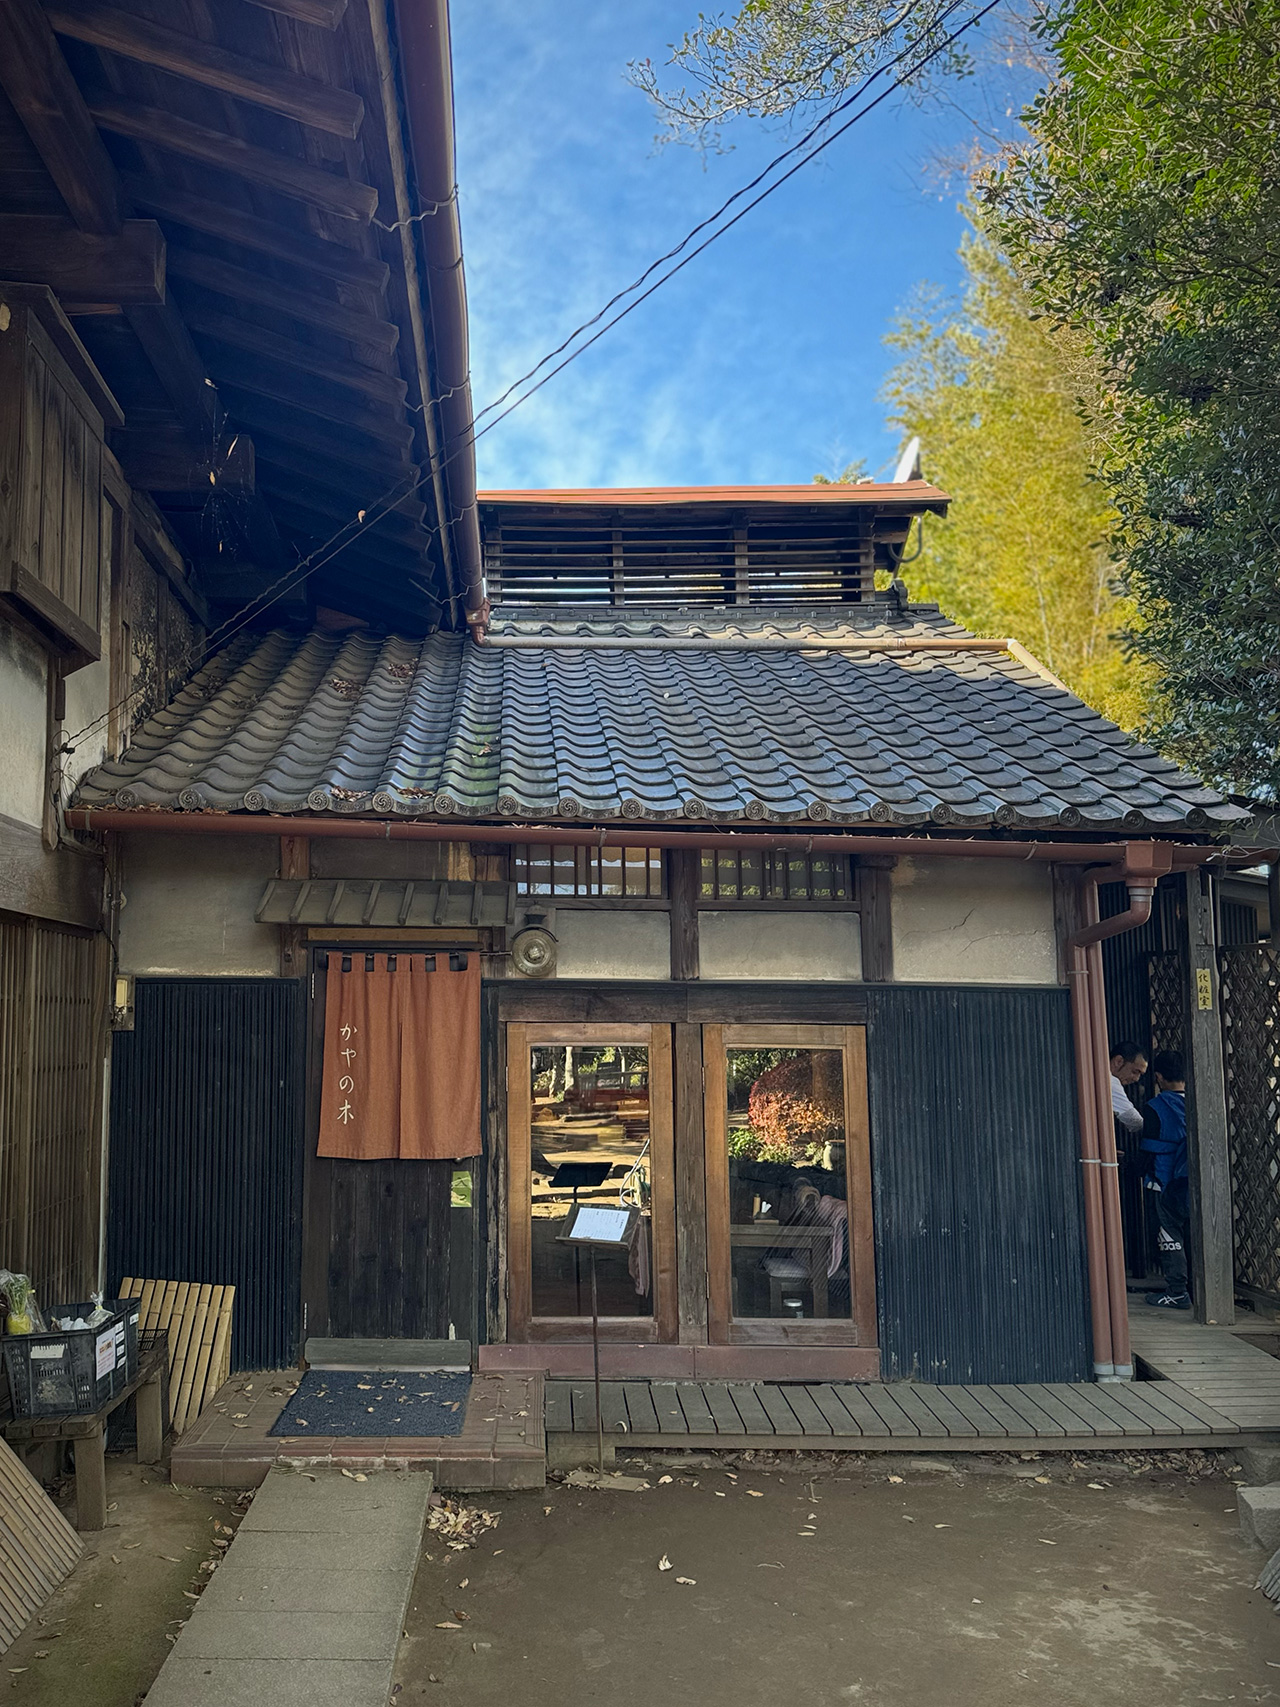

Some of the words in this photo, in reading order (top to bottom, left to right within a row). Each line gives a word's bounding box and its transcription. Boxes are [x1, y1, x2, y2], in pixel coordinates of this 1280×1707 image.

[1198, 973, 1210, 1006] 化粧室
[337, 1022, 358, 1125] かやの木
